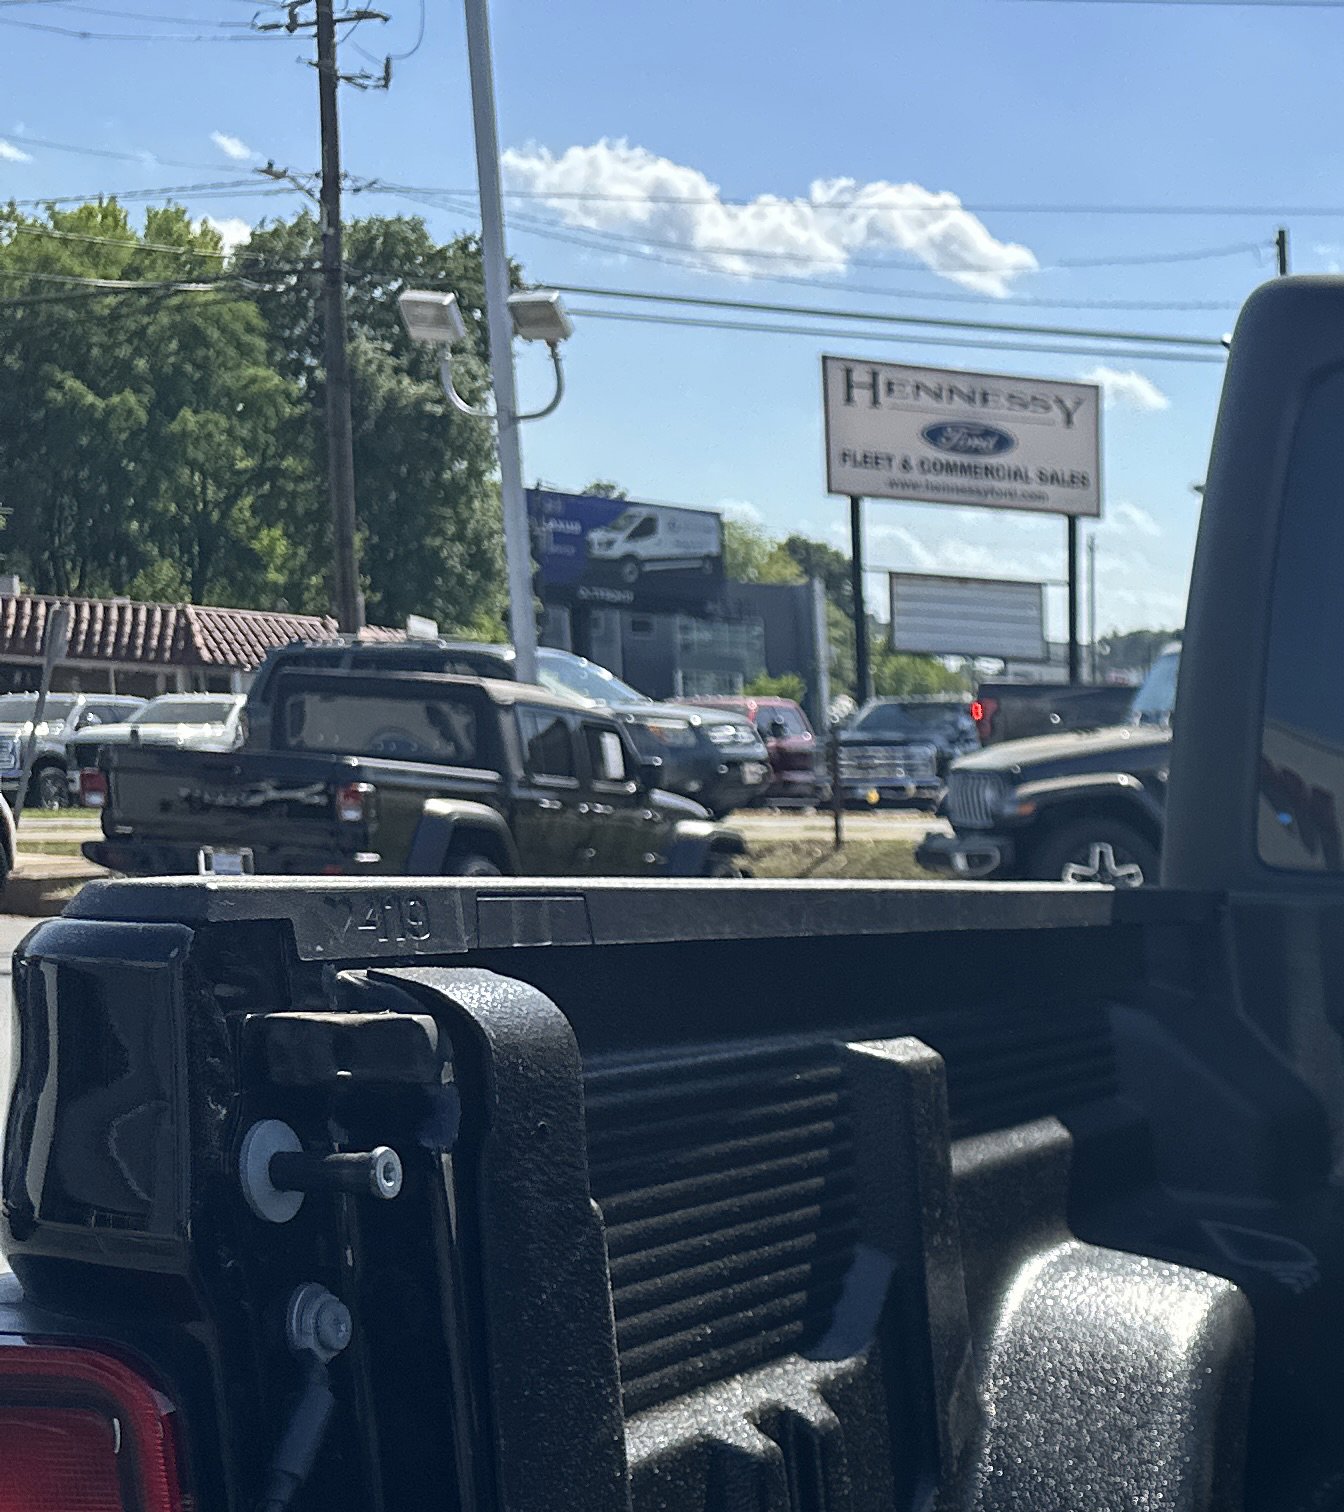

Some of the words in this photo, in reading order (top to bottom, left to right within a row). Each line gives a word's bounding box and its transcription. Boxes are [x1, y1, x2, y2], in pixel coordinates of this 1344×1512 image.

[842, 366, 1084, 428] HENNESSY
[938, 426, 998, 454] Ford
[840, 448, 895, 471] FLEET
[901, 456, 912, 473] &
[919, 457, 1032, 486] COMMERCIAL
[1036, 467, 1090, 491] SALES
